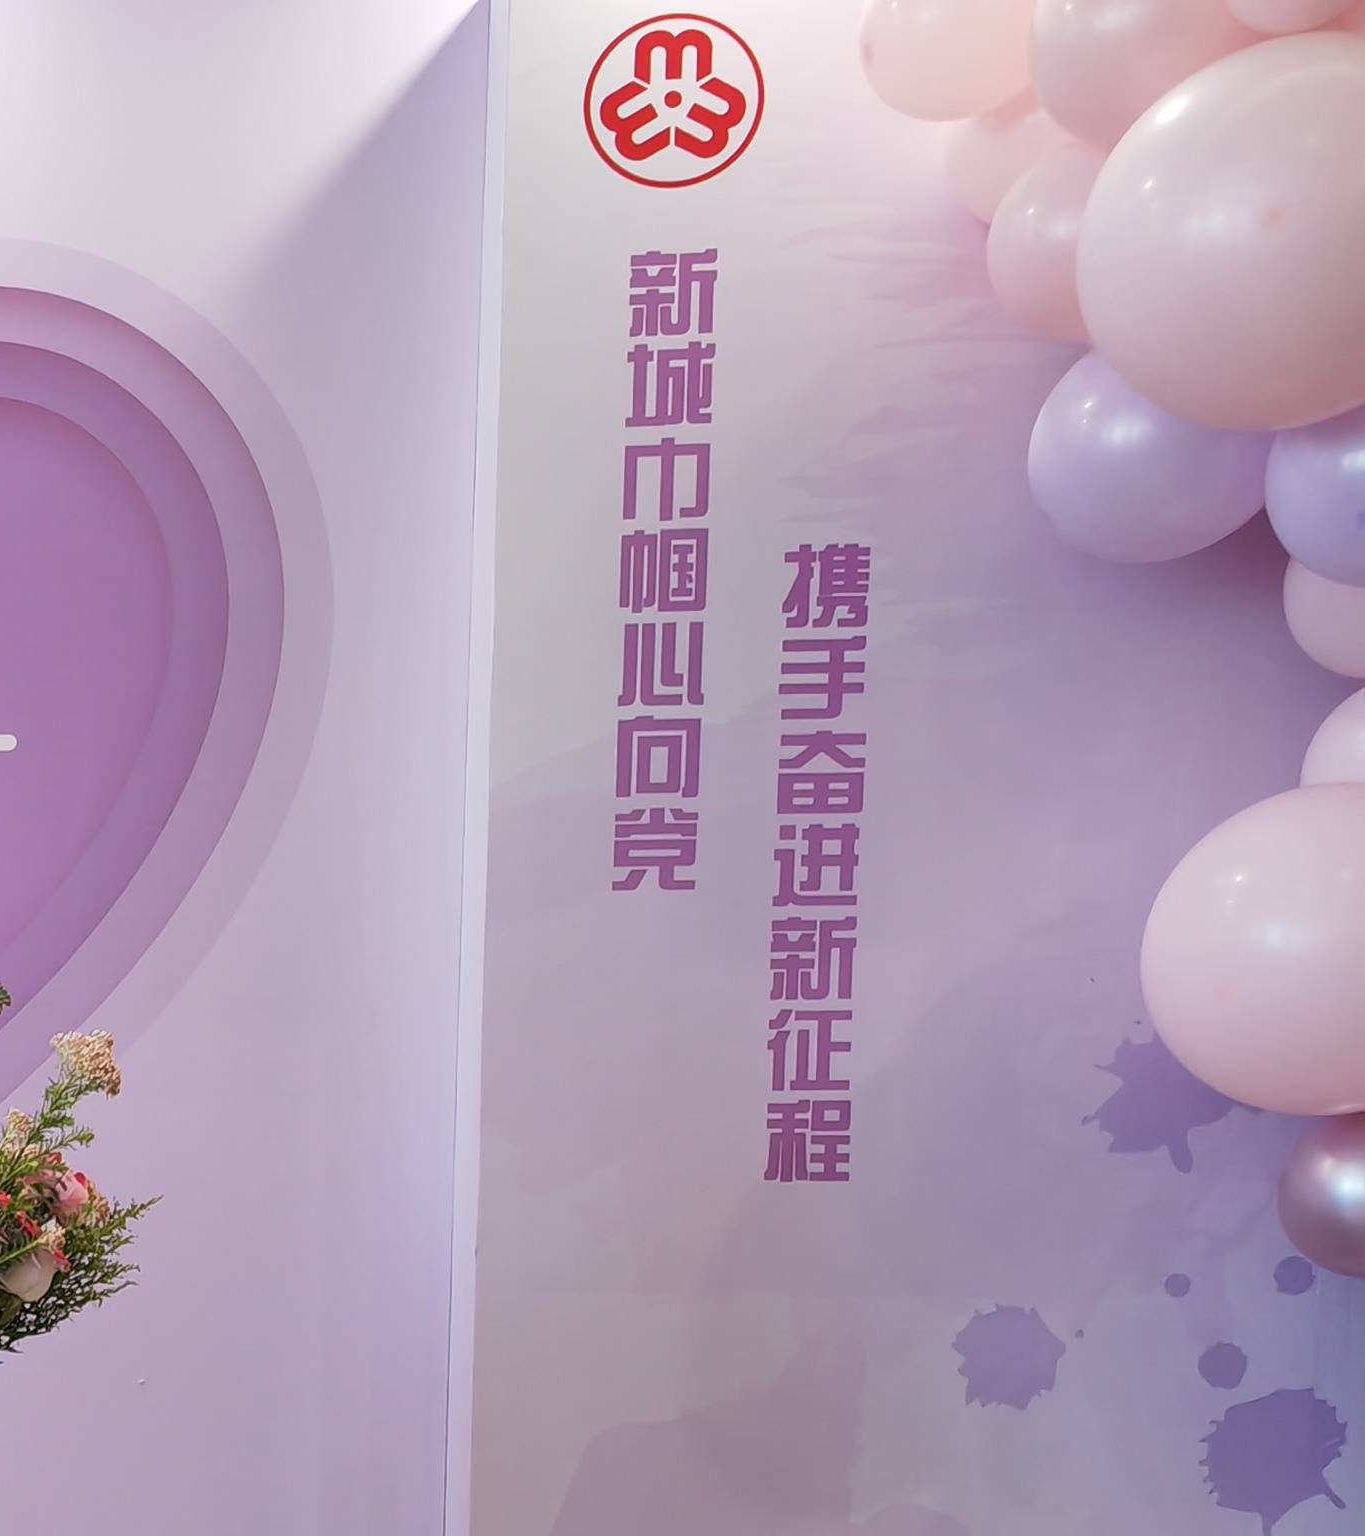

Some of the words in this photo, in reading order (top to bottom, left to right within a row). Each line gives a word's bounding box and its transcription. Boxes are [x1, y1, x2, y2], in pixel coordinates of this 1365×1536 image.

[611, 248, 718, 891] 新城巾帼心向党
[763, 543, 871, 1183] 携手奋进新征程
